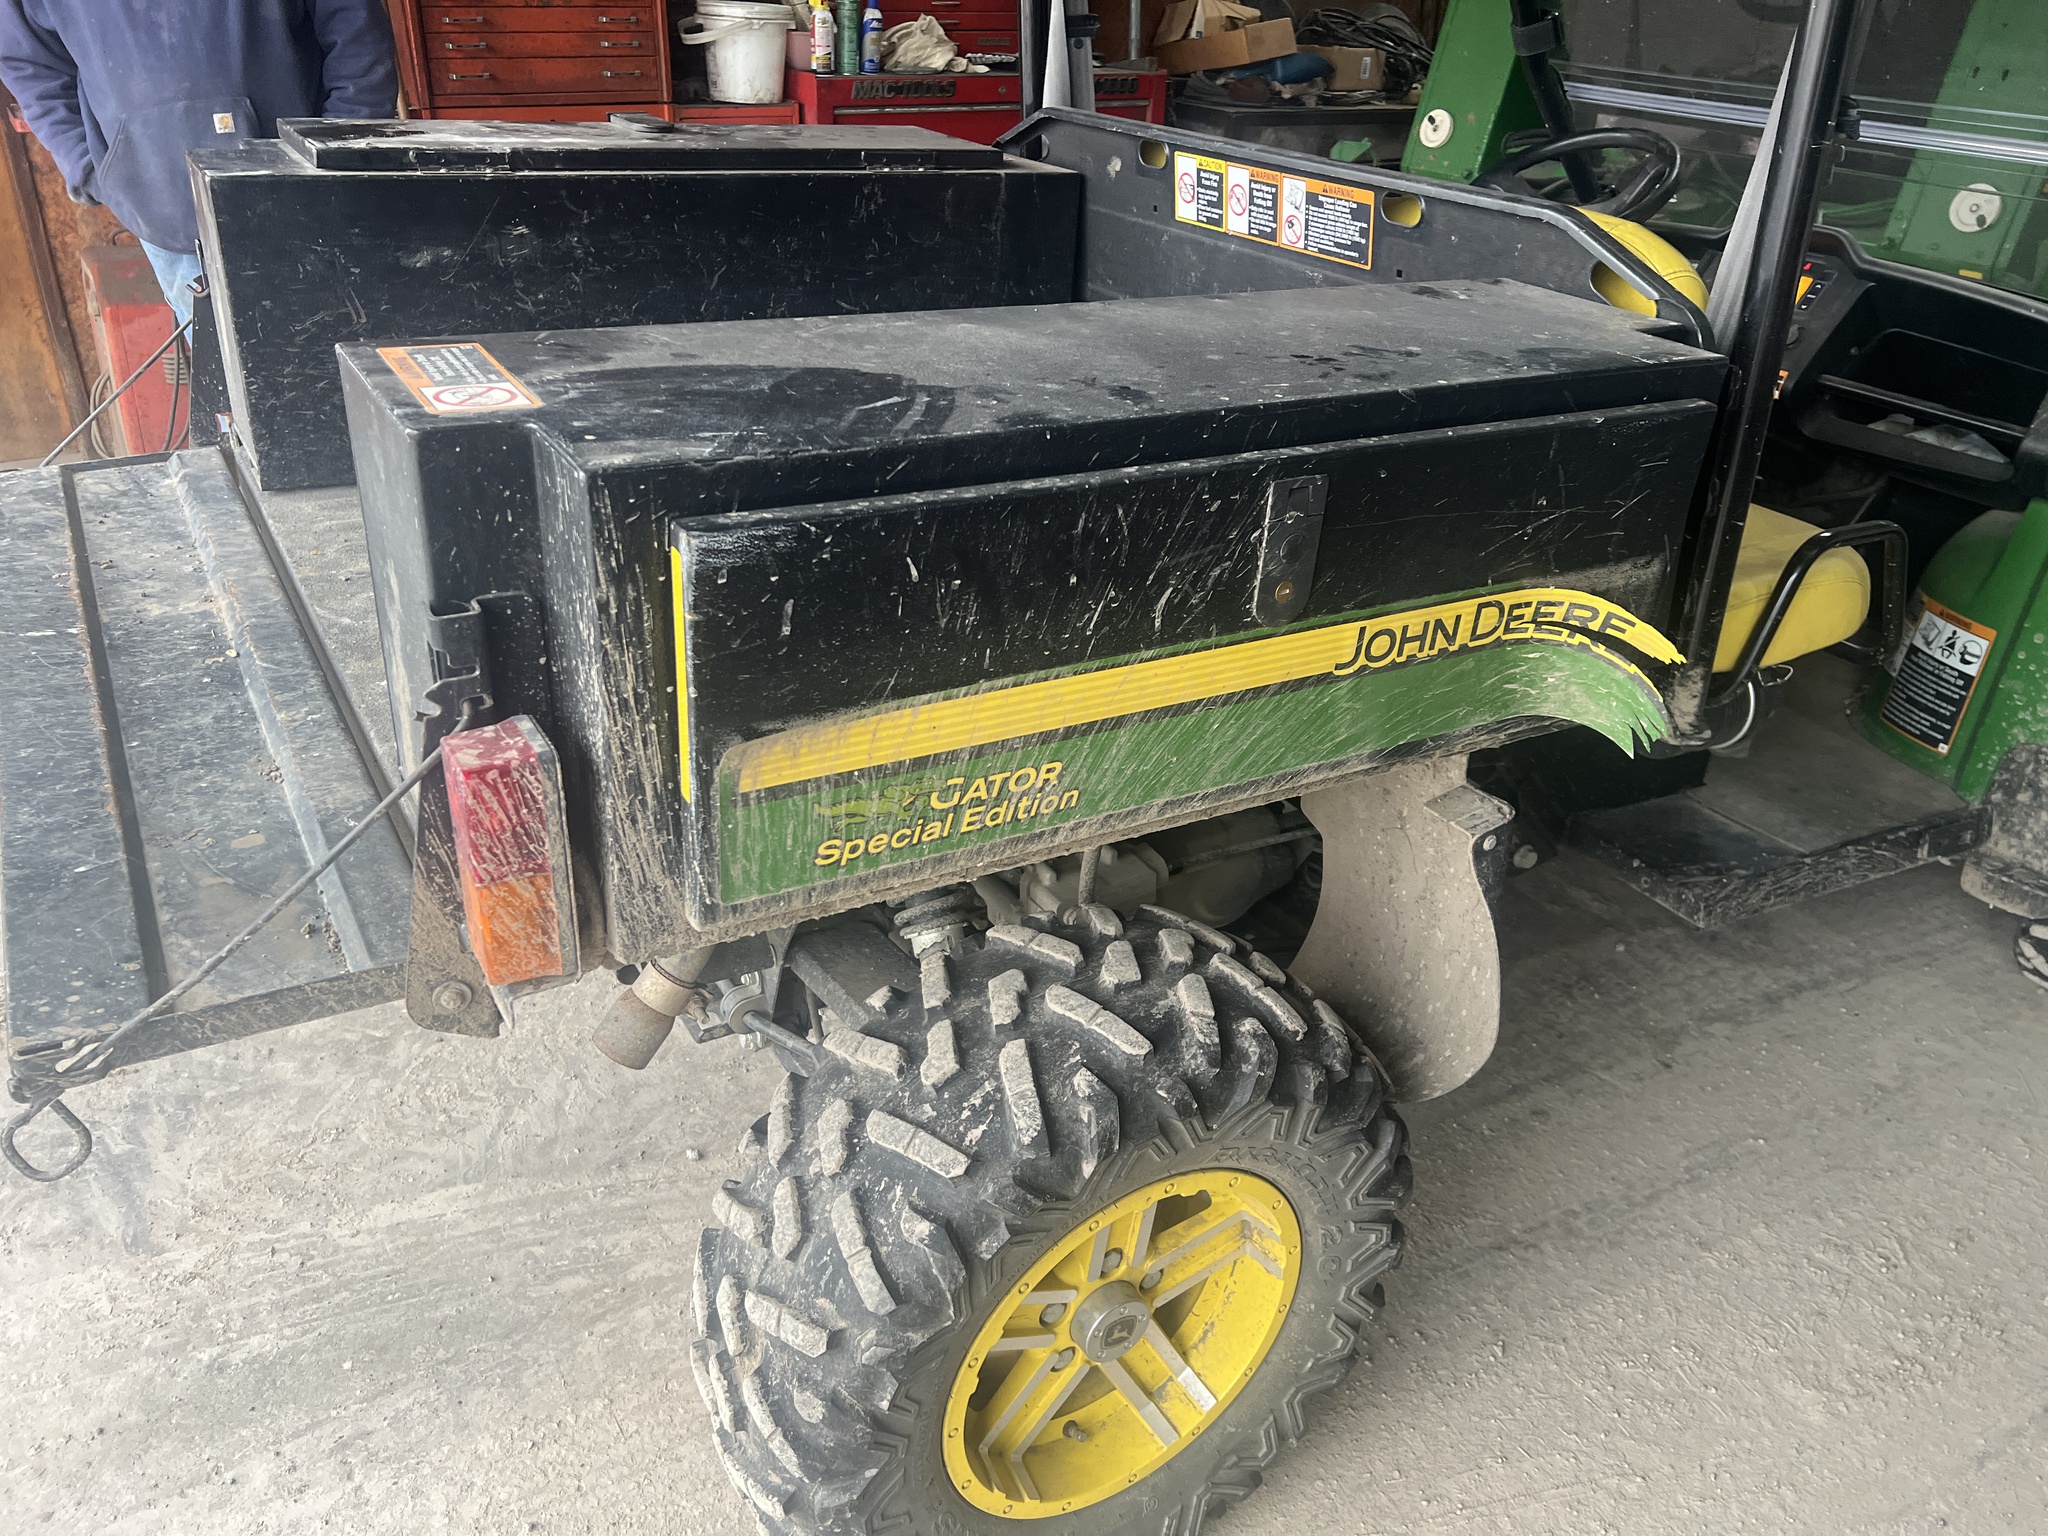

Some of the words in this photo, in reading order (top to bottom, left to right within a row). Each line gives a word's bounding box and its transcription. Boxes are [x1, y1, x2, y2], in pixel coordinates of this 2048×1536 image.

[851, 80, 897, 99] MAC
[1203, 159, 1223, 170] CAUTION
[1255, 169, 1279, 182] WARNING
[1328, 185, 1355, 199] WARNING
[1333, 614, 1463, 674] JOHN
[1469, 599, 1638, 644] DEERE
[929, 761, 1064, 811] GATOR
[814, 812, 953, 867] Special
[960, 789, 1080, 834] Edition
